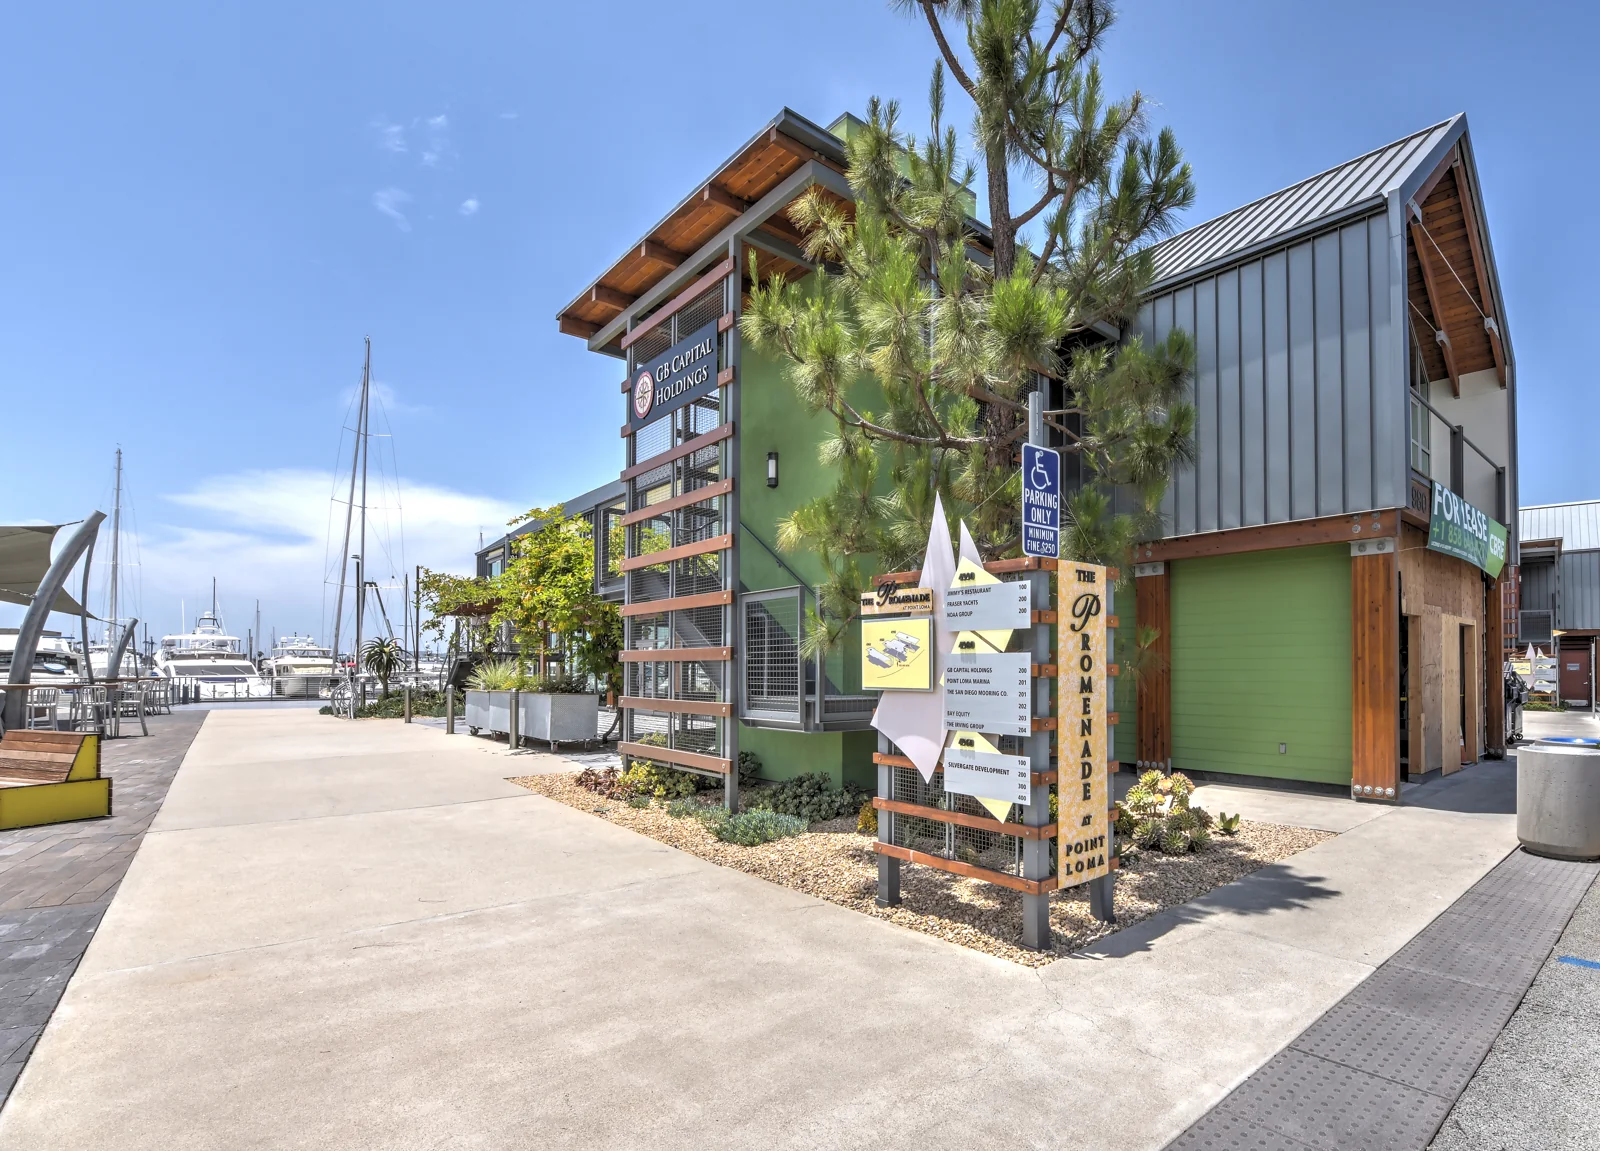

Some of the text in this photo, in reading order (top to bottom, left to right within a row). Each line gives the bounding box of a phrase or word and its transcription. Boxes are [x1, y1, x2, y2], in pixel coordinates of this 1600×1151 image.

[656, 338, 712, 382] GB CAPITAL
[656, 365, 708, 406] HOLDINGS
[1025, 488, 1057, 509] PARKING
[1031, 507, 1051, 524] ONLY
[1434, 482, 1487, 542] FOR LEASE
[1029, 527, 1054, 541] MINIMUM
[1433, 521, 1444, 540] +1
[1448, 524, 1462, 546] 858
[1027, 540, 1055, 554] FINE $250
[1490, 534, 1504, 560] CBRE
[1076, 570, 1096, 583] THE
[861, 580, 930, 606] THE PROMENADE
[965, 587, 991, 595] RESTAURANT
[1070, 593, 1101, 802] PROMENADE
[948, 762, 1009, 776] SILVERGATE DEVELOPMENT
[1081, 814, 1092, 827] AT
[1066, 835, 1105, 857] POINT
[1066, 854, 1105, 876] LOMA
